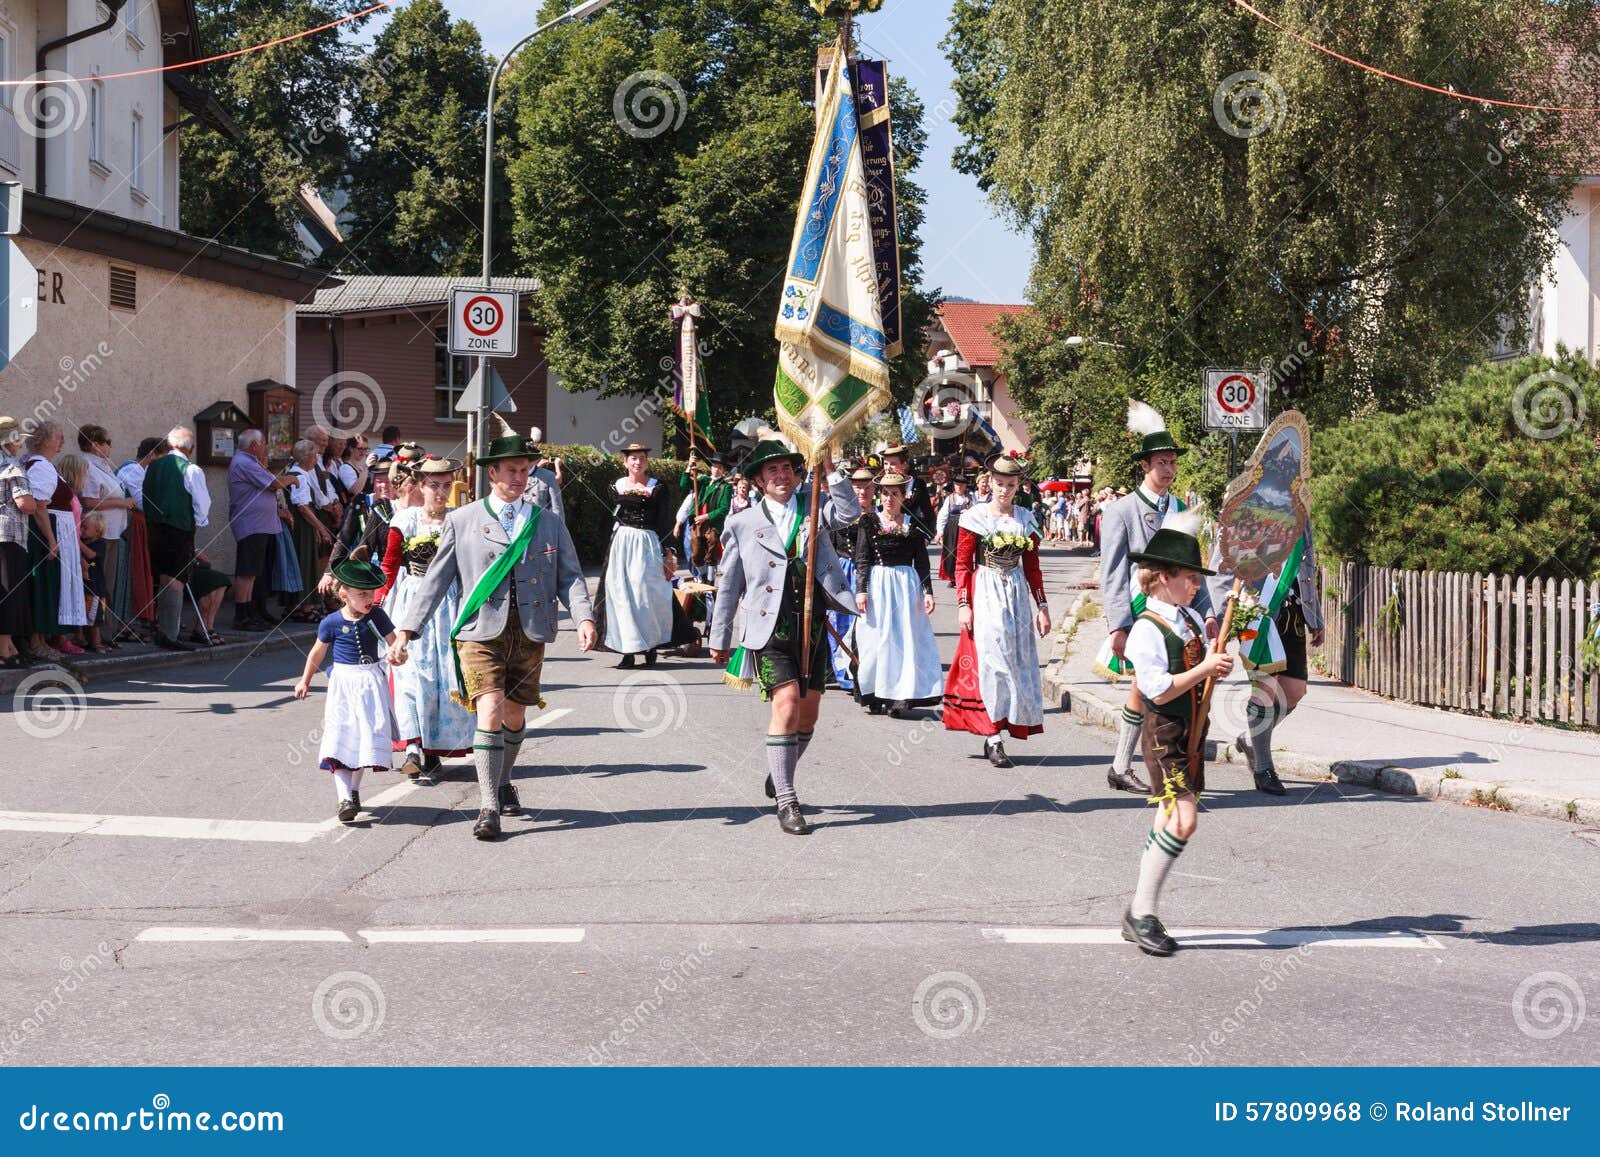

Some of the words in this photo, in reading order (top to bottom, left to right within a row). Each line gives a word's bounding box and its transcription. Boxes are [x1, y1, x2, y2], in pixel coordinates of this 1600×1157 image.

[472, 306, 496, 326] 30
[467, 337, 499, 349] ZONE
[1225, 385, 1248, 403] 30
[1221, 415, 1251, 425] ZONE
